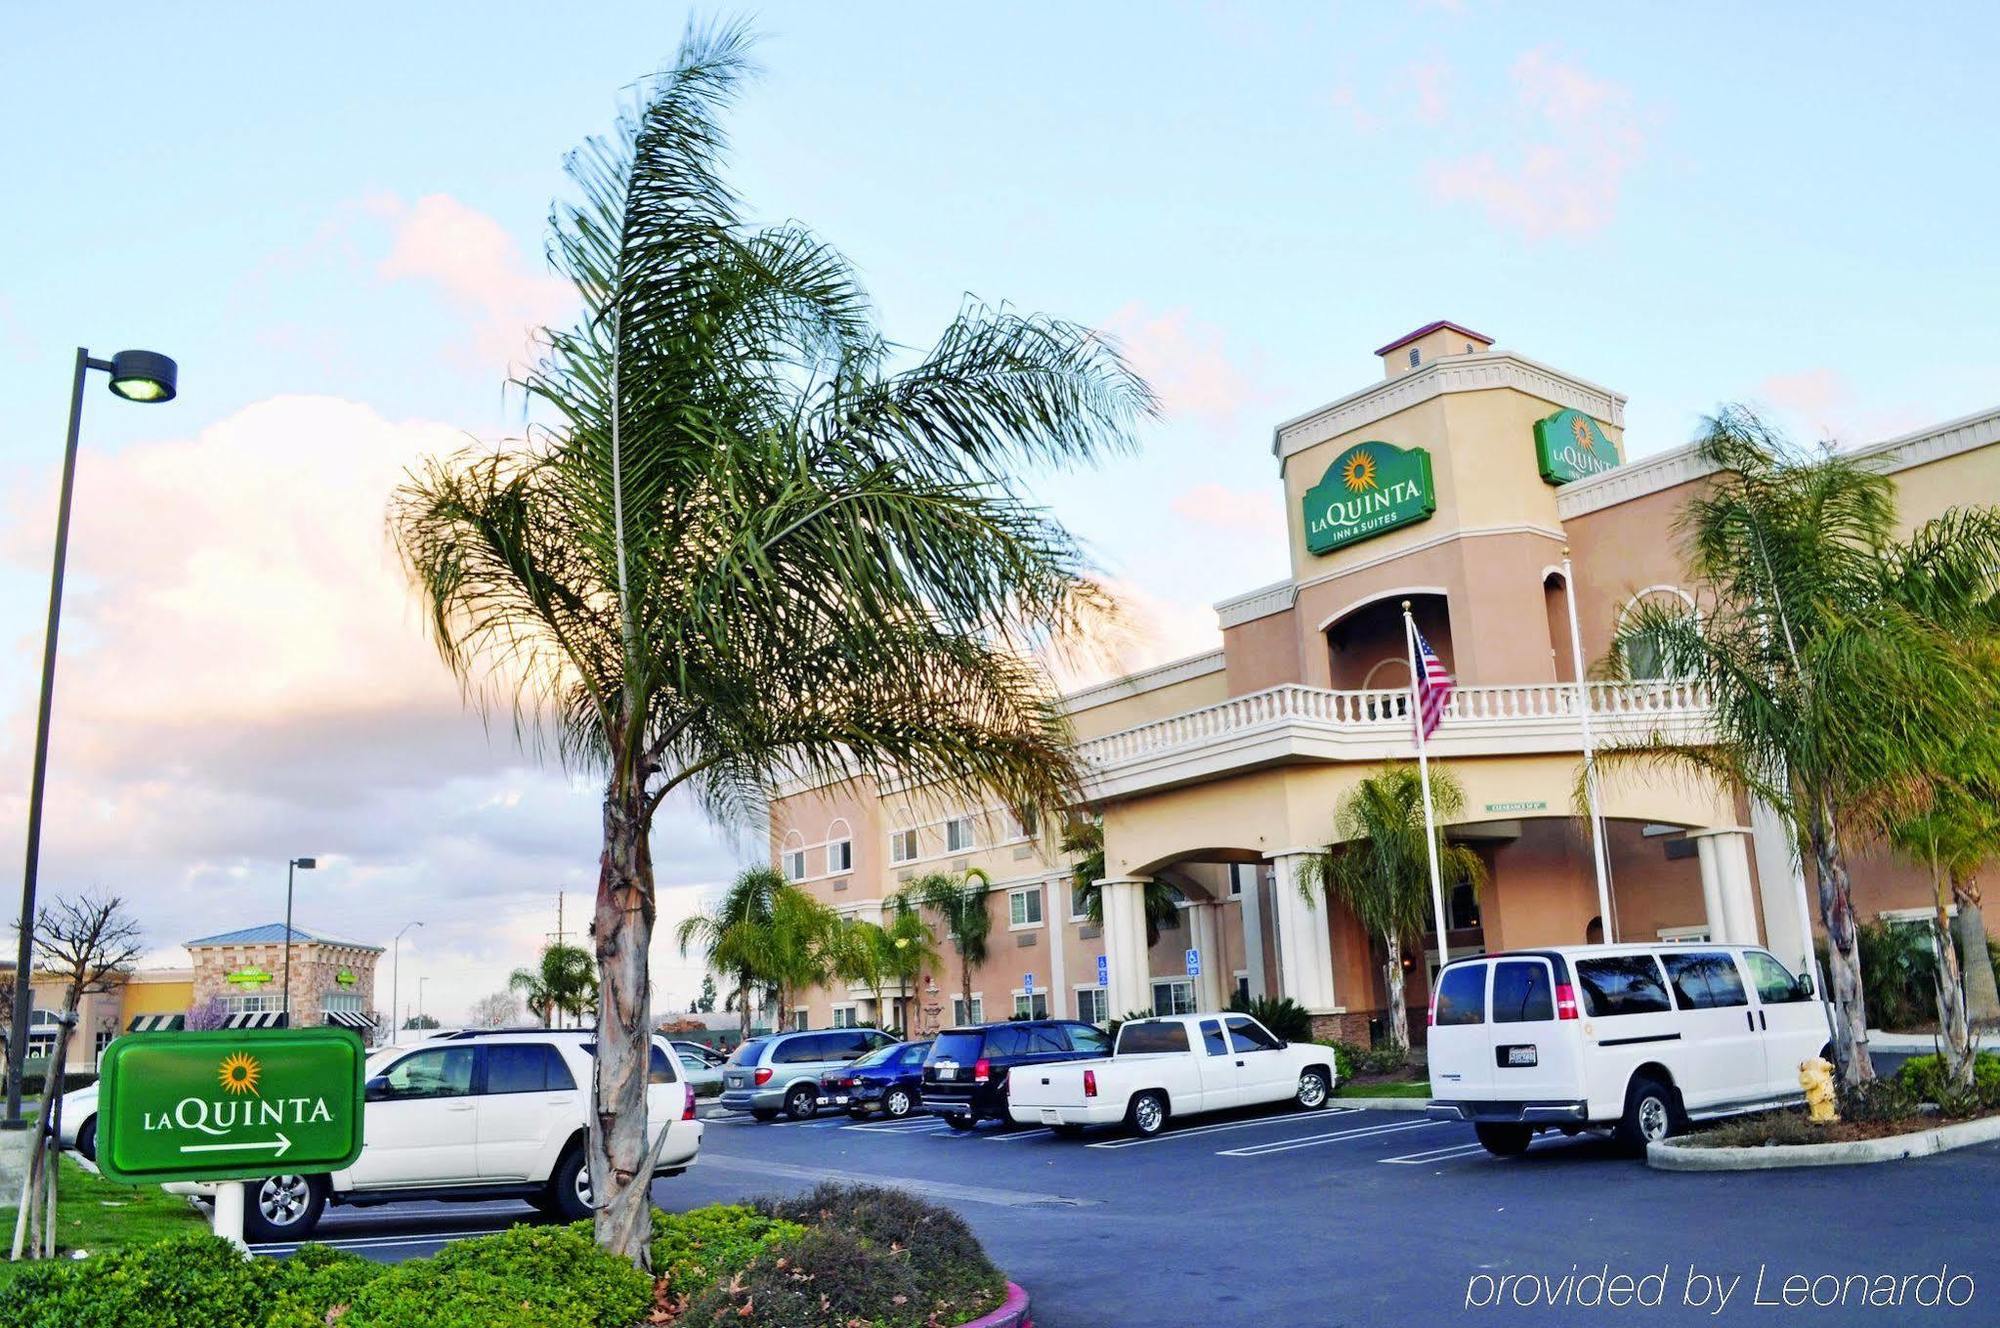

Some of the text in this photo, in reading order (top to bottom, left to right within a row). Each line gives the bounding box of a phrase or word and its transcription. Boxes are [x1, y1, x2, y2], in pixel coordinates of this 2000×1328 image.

[1552, 449, 1565, 463] LA
[1311, 480, 1420, 533] LA QUINTA
[1333, 528, 1351, 541] INN
[1361, 512, 1397, 532] SUITES
[144, 1097, 333, 1135] LA QUINTA
